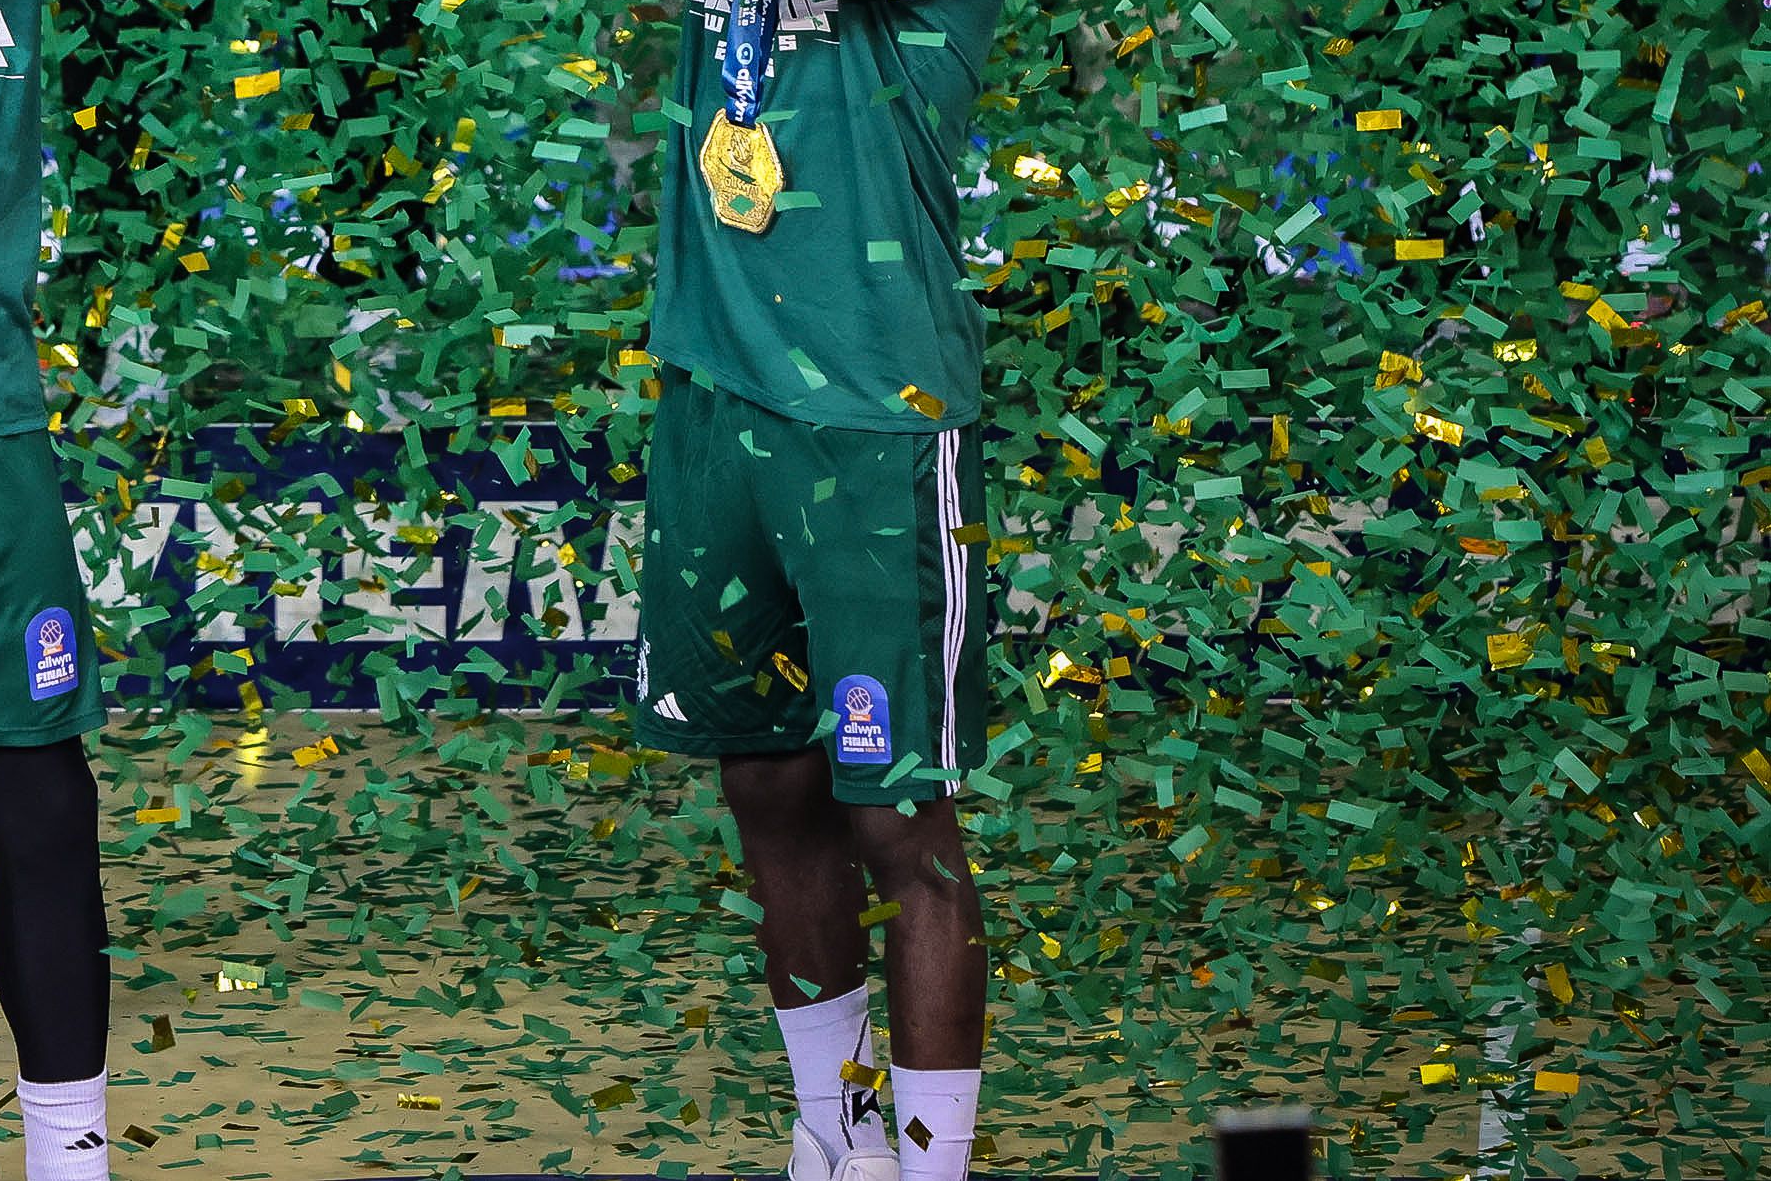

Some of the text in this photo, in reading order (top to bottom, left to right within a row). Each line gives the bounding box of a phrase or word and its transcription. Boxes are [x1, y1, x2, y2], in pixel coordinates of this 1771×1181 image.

[37, 652, 72, 670] allwyn
[36, 667, 68, 683] FINAL
[843, 722, 882, 737] allwyn
